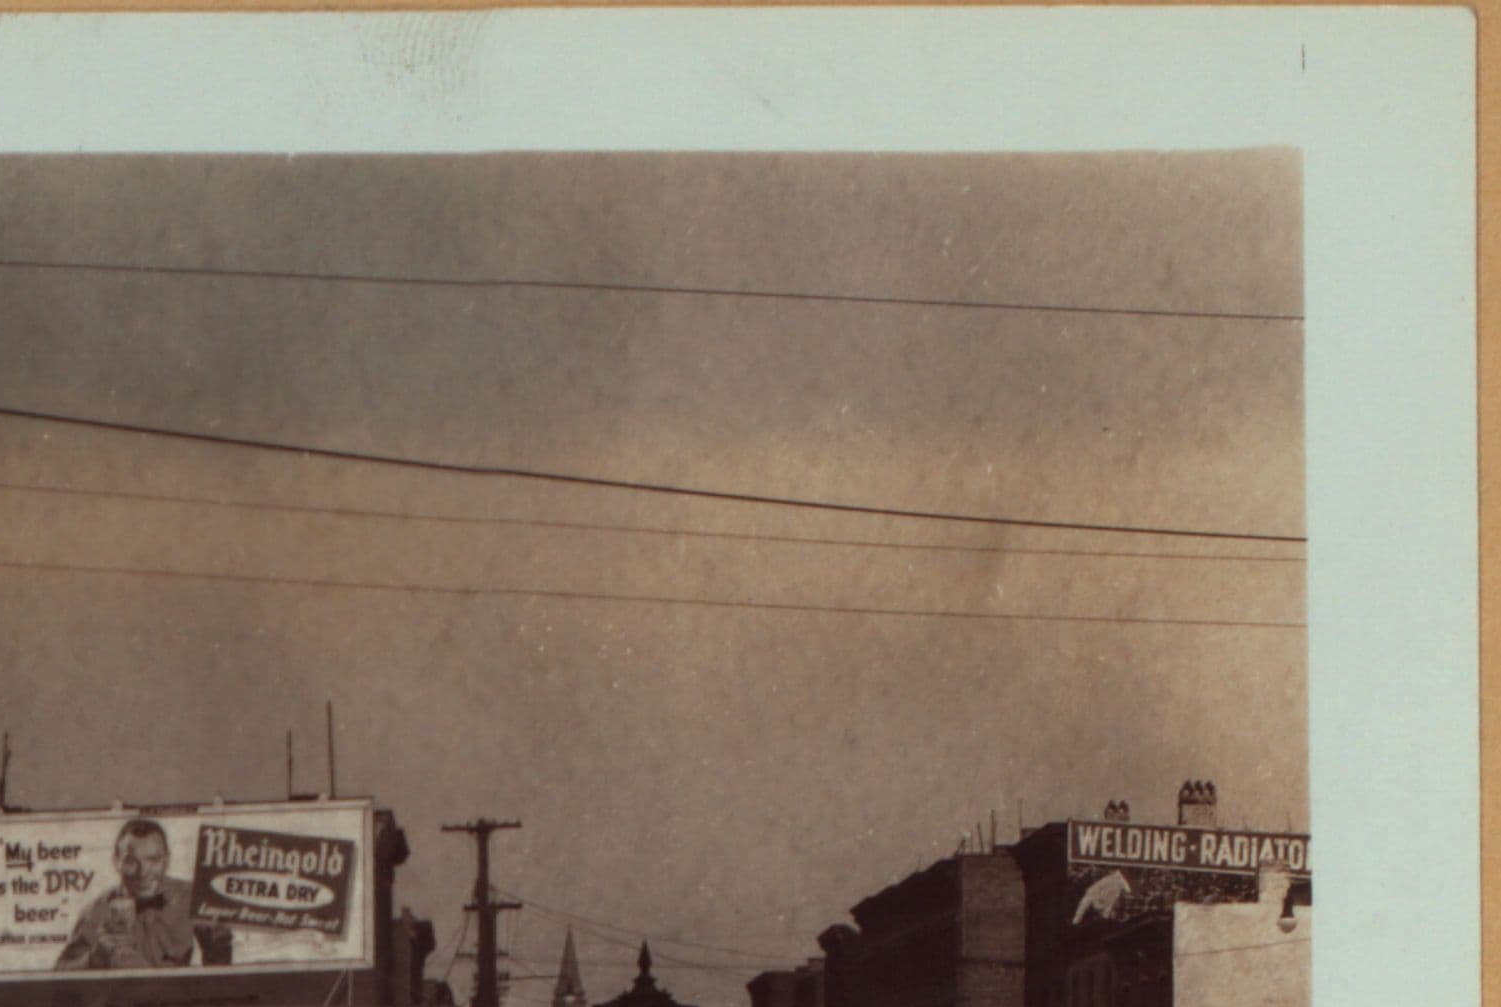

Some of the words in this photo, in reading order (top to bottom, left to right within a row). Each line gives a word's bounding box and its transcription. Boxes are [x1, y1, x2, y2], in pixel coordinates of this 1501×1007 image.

[37, 841, 82, 860] beer
[202, 828, 344, 877] Rheingold
[11, 876, 39, 895] the
[43, 869, 95, 895] DRY
[225, 876, 279, 899] EXTRA
[286, 883, 320, 903] DRY
